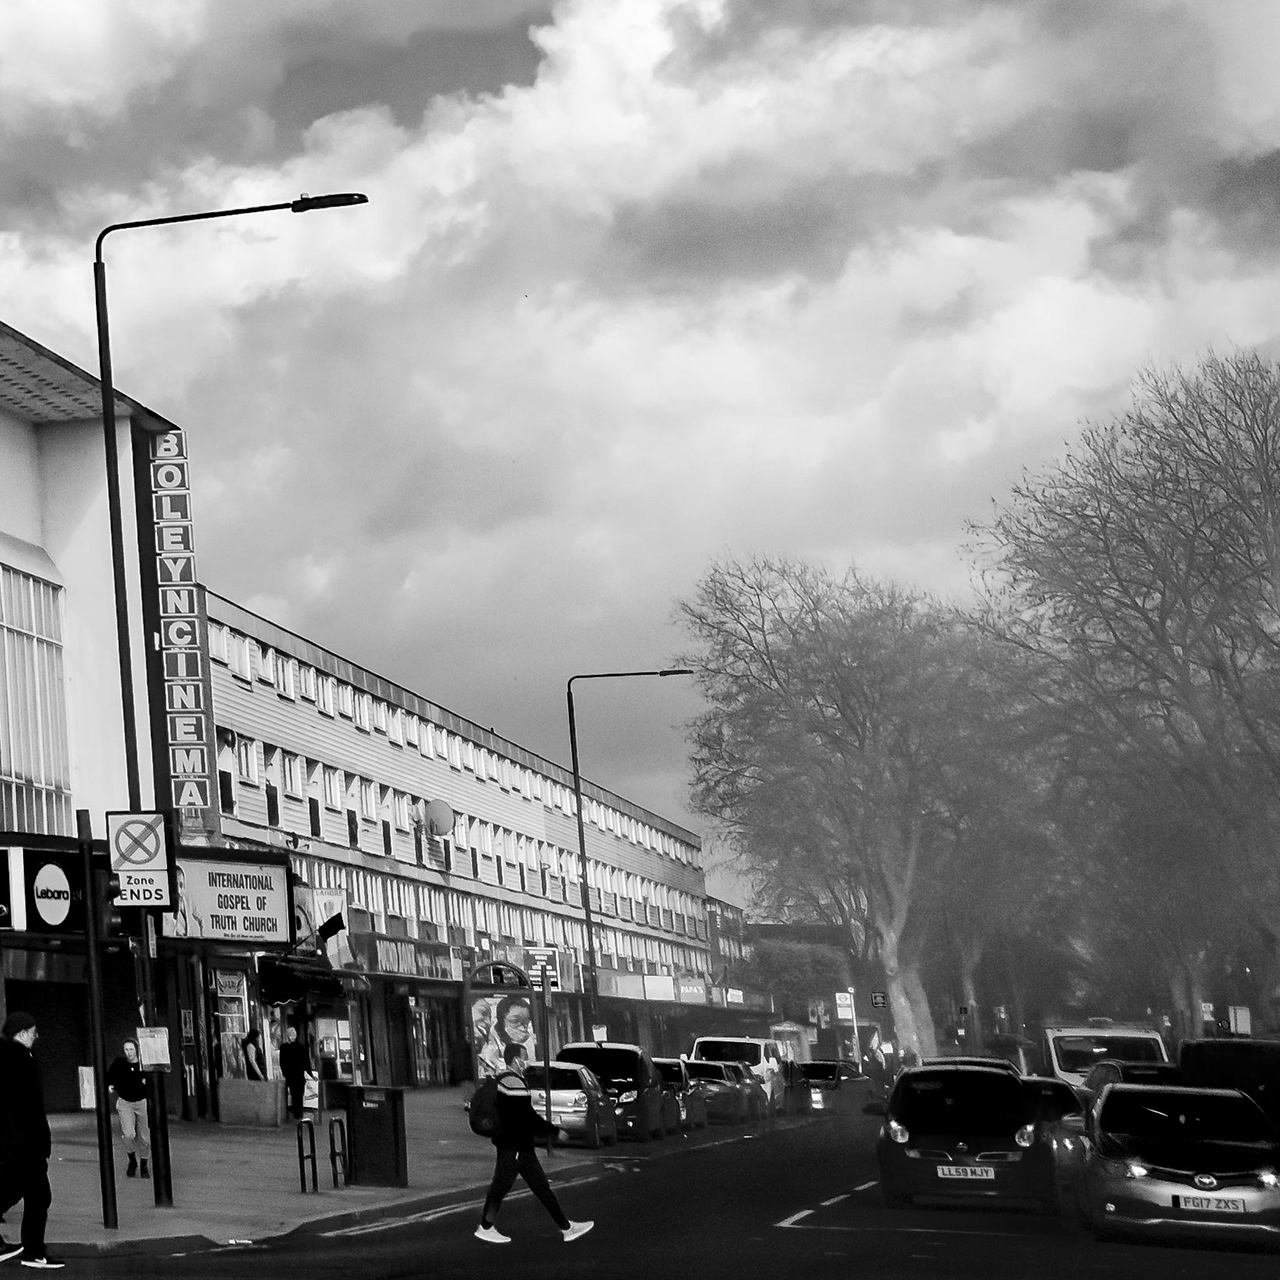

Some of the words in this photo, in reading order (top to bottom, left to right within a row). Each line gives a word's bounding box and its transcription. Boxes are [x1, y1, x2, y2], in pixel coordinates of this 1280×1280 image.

[155, 432, 190, 614] BOLEYN
[168, 621, 204, 806] CINEMA
[126, 875, 154, 885] Zone
[208, 871, 274, 891] INTERNATIONAL
[35, 886, 69, 901] Lebara
[120, 888, 164, 901] ENDS
[217, 893, 251, 911] GOSPEL
[256, 896, 267, 911] OF
[210, 914, 237, 931] TRUTH
[243, 916, 278, 932] CHURCH
[681, 986, 704, 994] PAPA'S
[941, 1167, 968, 1177] LL59
[1183, 1196, 1211, 1208] FG17
[1215, 1198, 1239, 1210] ZXS
